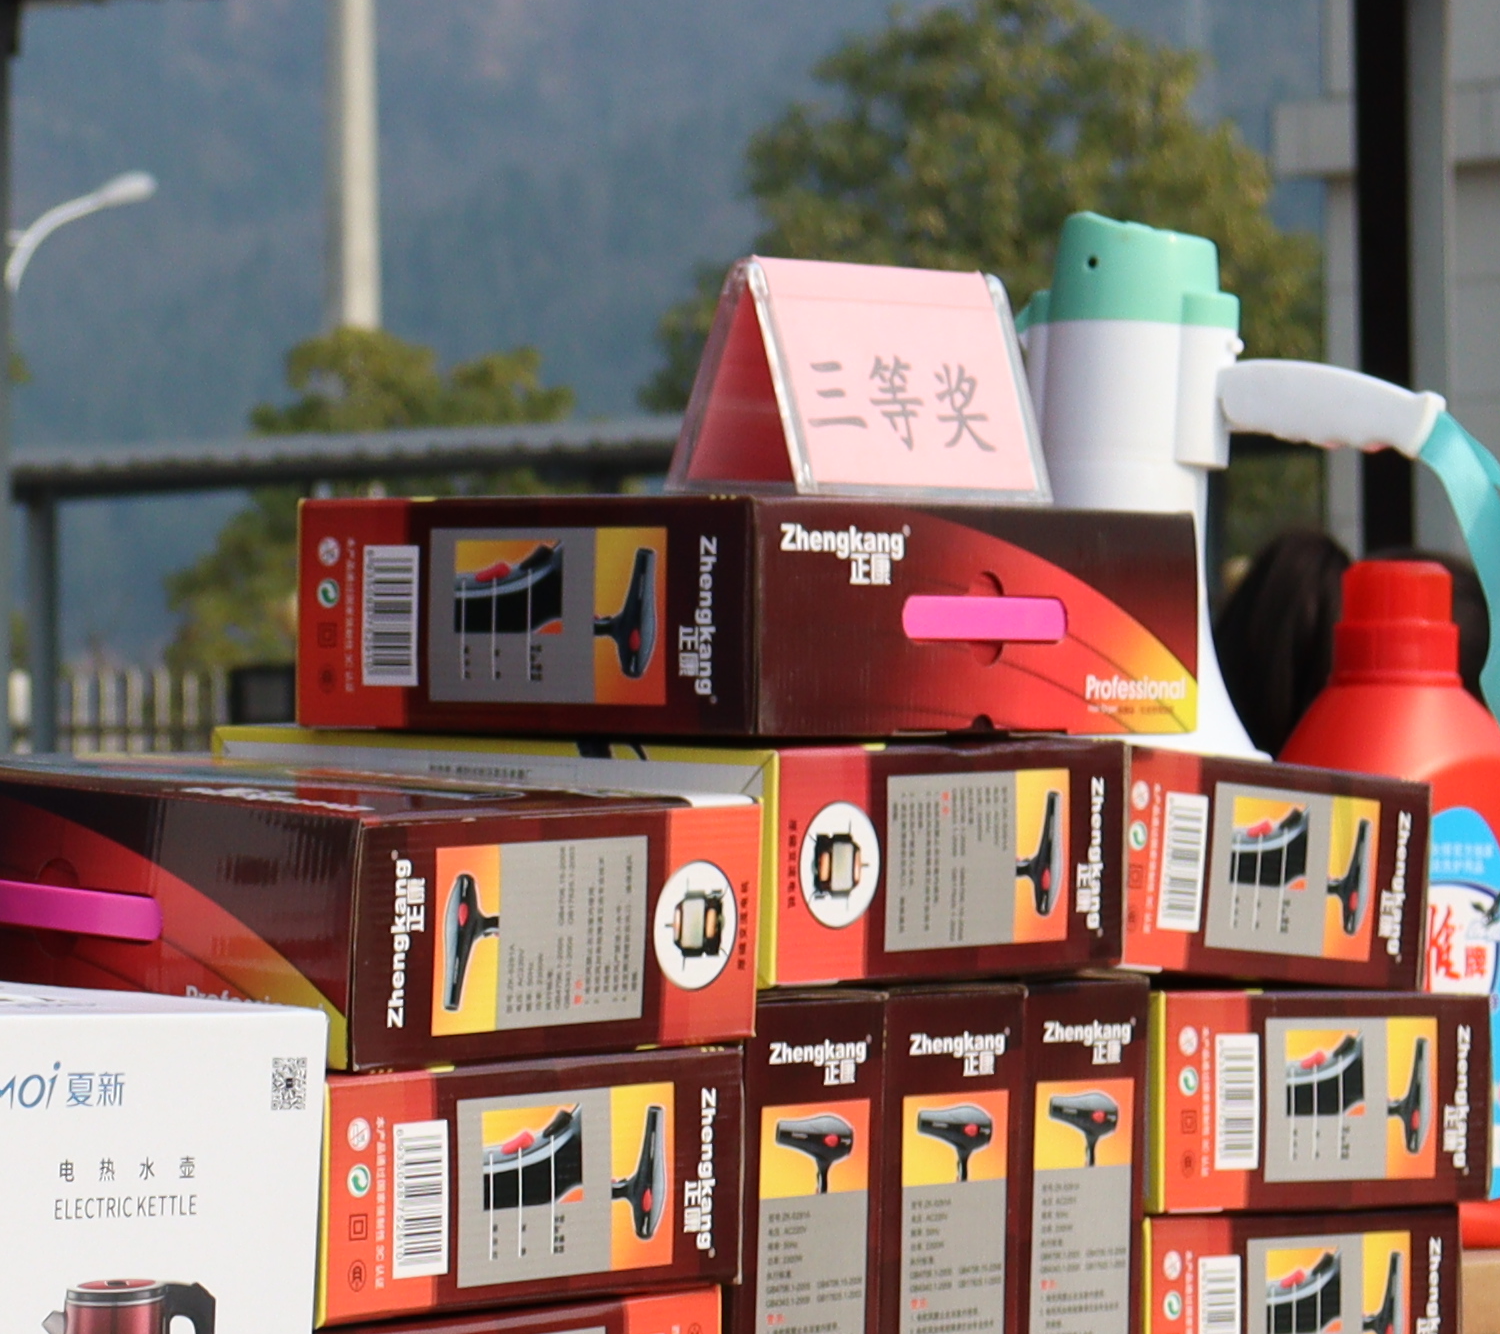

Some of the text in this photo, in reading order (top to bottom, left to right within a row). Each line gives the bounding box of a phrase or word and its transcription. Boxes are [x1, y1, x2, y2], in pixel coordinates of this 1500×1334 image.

[808, 355, 998, 452] 三等奖
[780, 522, 904, 559] Zhengkang
[695, 535, 717, 696] Zhengkang
[1085, 675, 1185, 699] Professional
[387, 858, 412, 1028] Zhengkang
[909, 1030, 1006, 1061] Zhengkang
[1043, 1019, 1132, 1051] Zhengkang
[769, 1038, 867, 1068] Zhengkang
[66, 1070, 126, 1110] 夏新
[58, 1155, 196, 1183] 电热水壶
[696, 1088, 719, 1251] Zhengkang
[54, 1193, 198, 1221] ELECTRIC KETTLE
